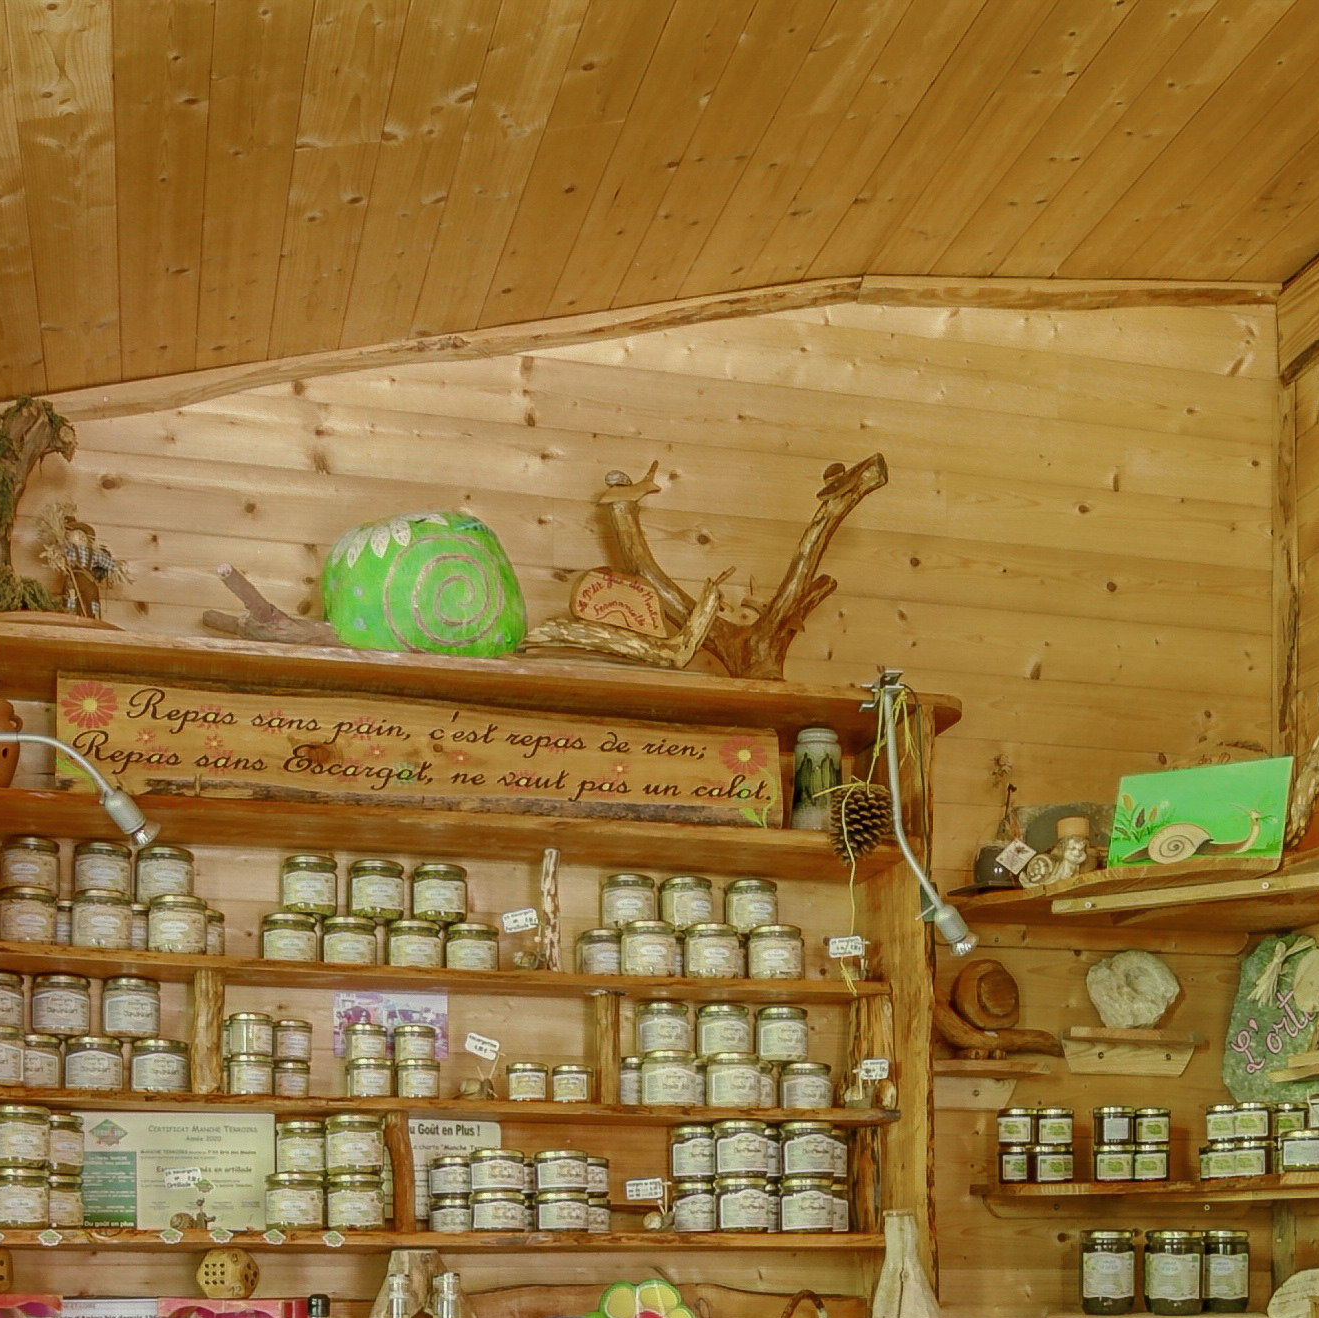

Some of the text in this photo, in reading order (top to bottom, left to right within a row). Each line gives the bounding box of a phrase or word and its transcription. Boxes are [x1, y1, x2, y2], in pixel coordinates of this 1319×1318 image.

[126, 688, 237, 734] Repas
[250, 712, 322, 733] sans
[324, 717, 411, 745] pain,
[505, 732, 586, 759] repas
[598, 731, 630, 754] de
[72, 729, 182, 774] Repas
[194, 753, 267, 773] sans
[450, 770, 485, 787] ne
[496, 769, 567, 790] vaut
[569, 776, 631, 802] pas
[642, 781, 681, 797] un
[417, 1123, 475, 1136] Goût en Plus
